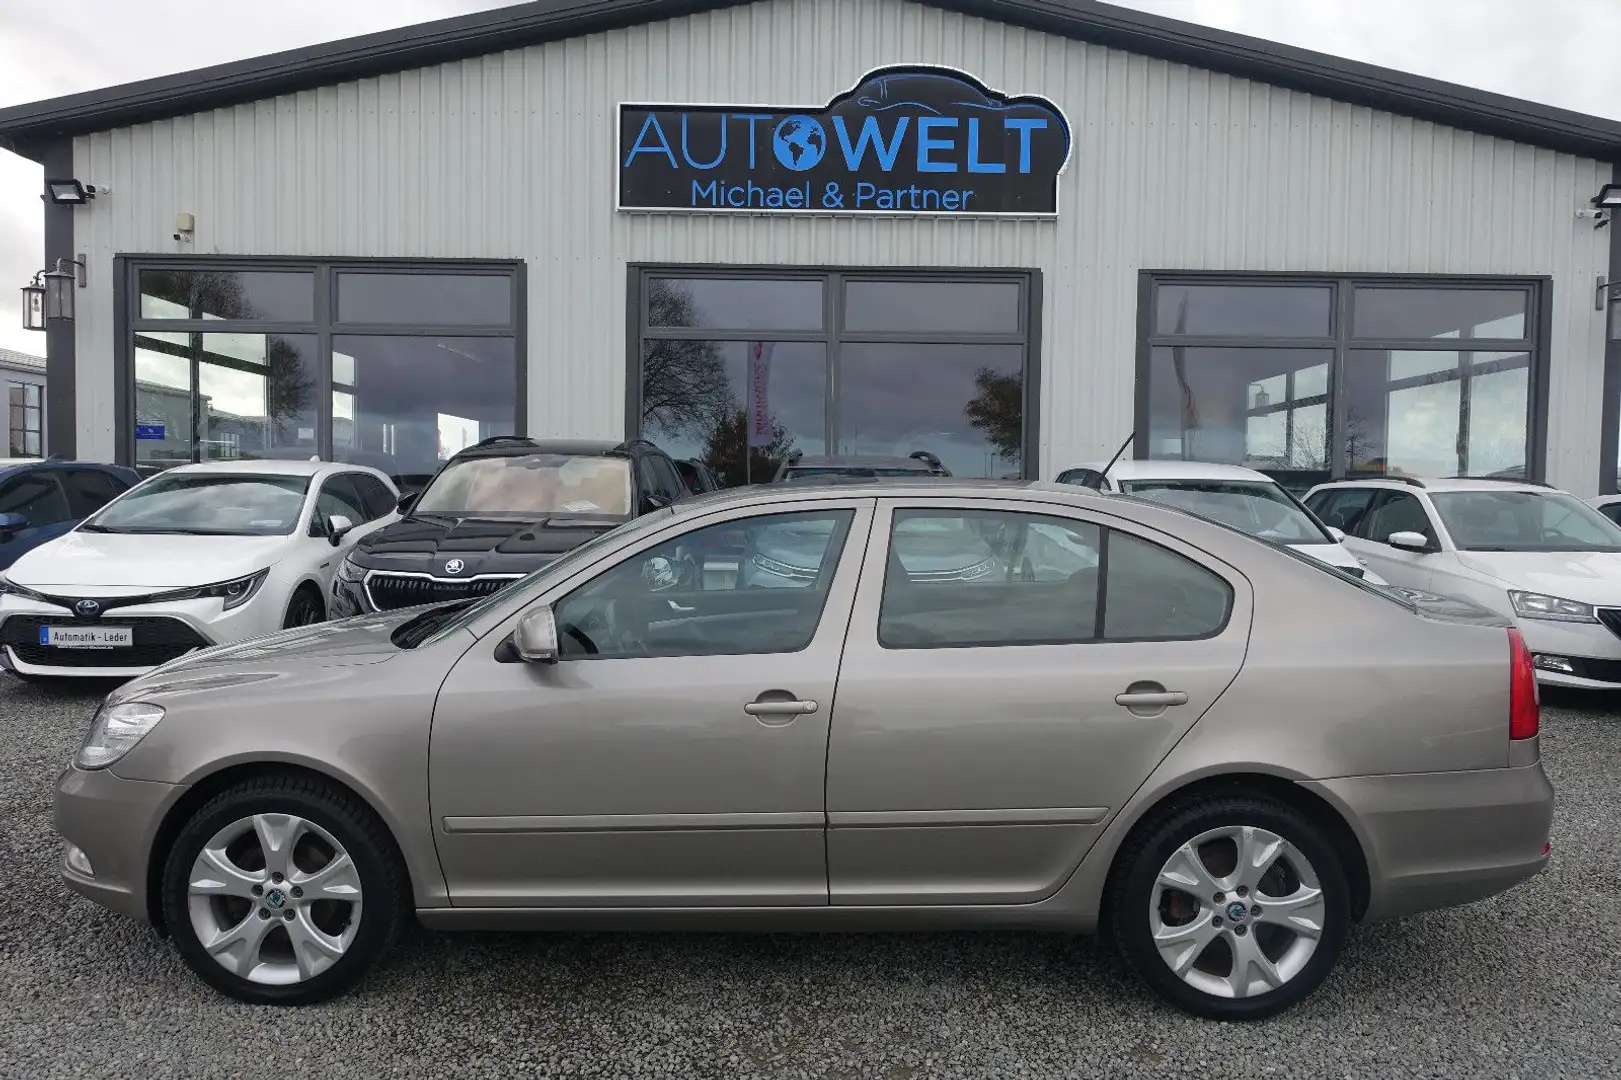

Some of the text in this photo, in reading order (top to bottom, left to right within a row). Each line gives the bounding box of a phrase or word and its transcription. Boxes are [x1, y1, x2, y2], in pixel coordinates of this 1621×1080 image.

[691, 180, 974, 210] Michael & Partner
[53, 631, 96, 642] Automatik
[104, 632, 127, 642] Leder
